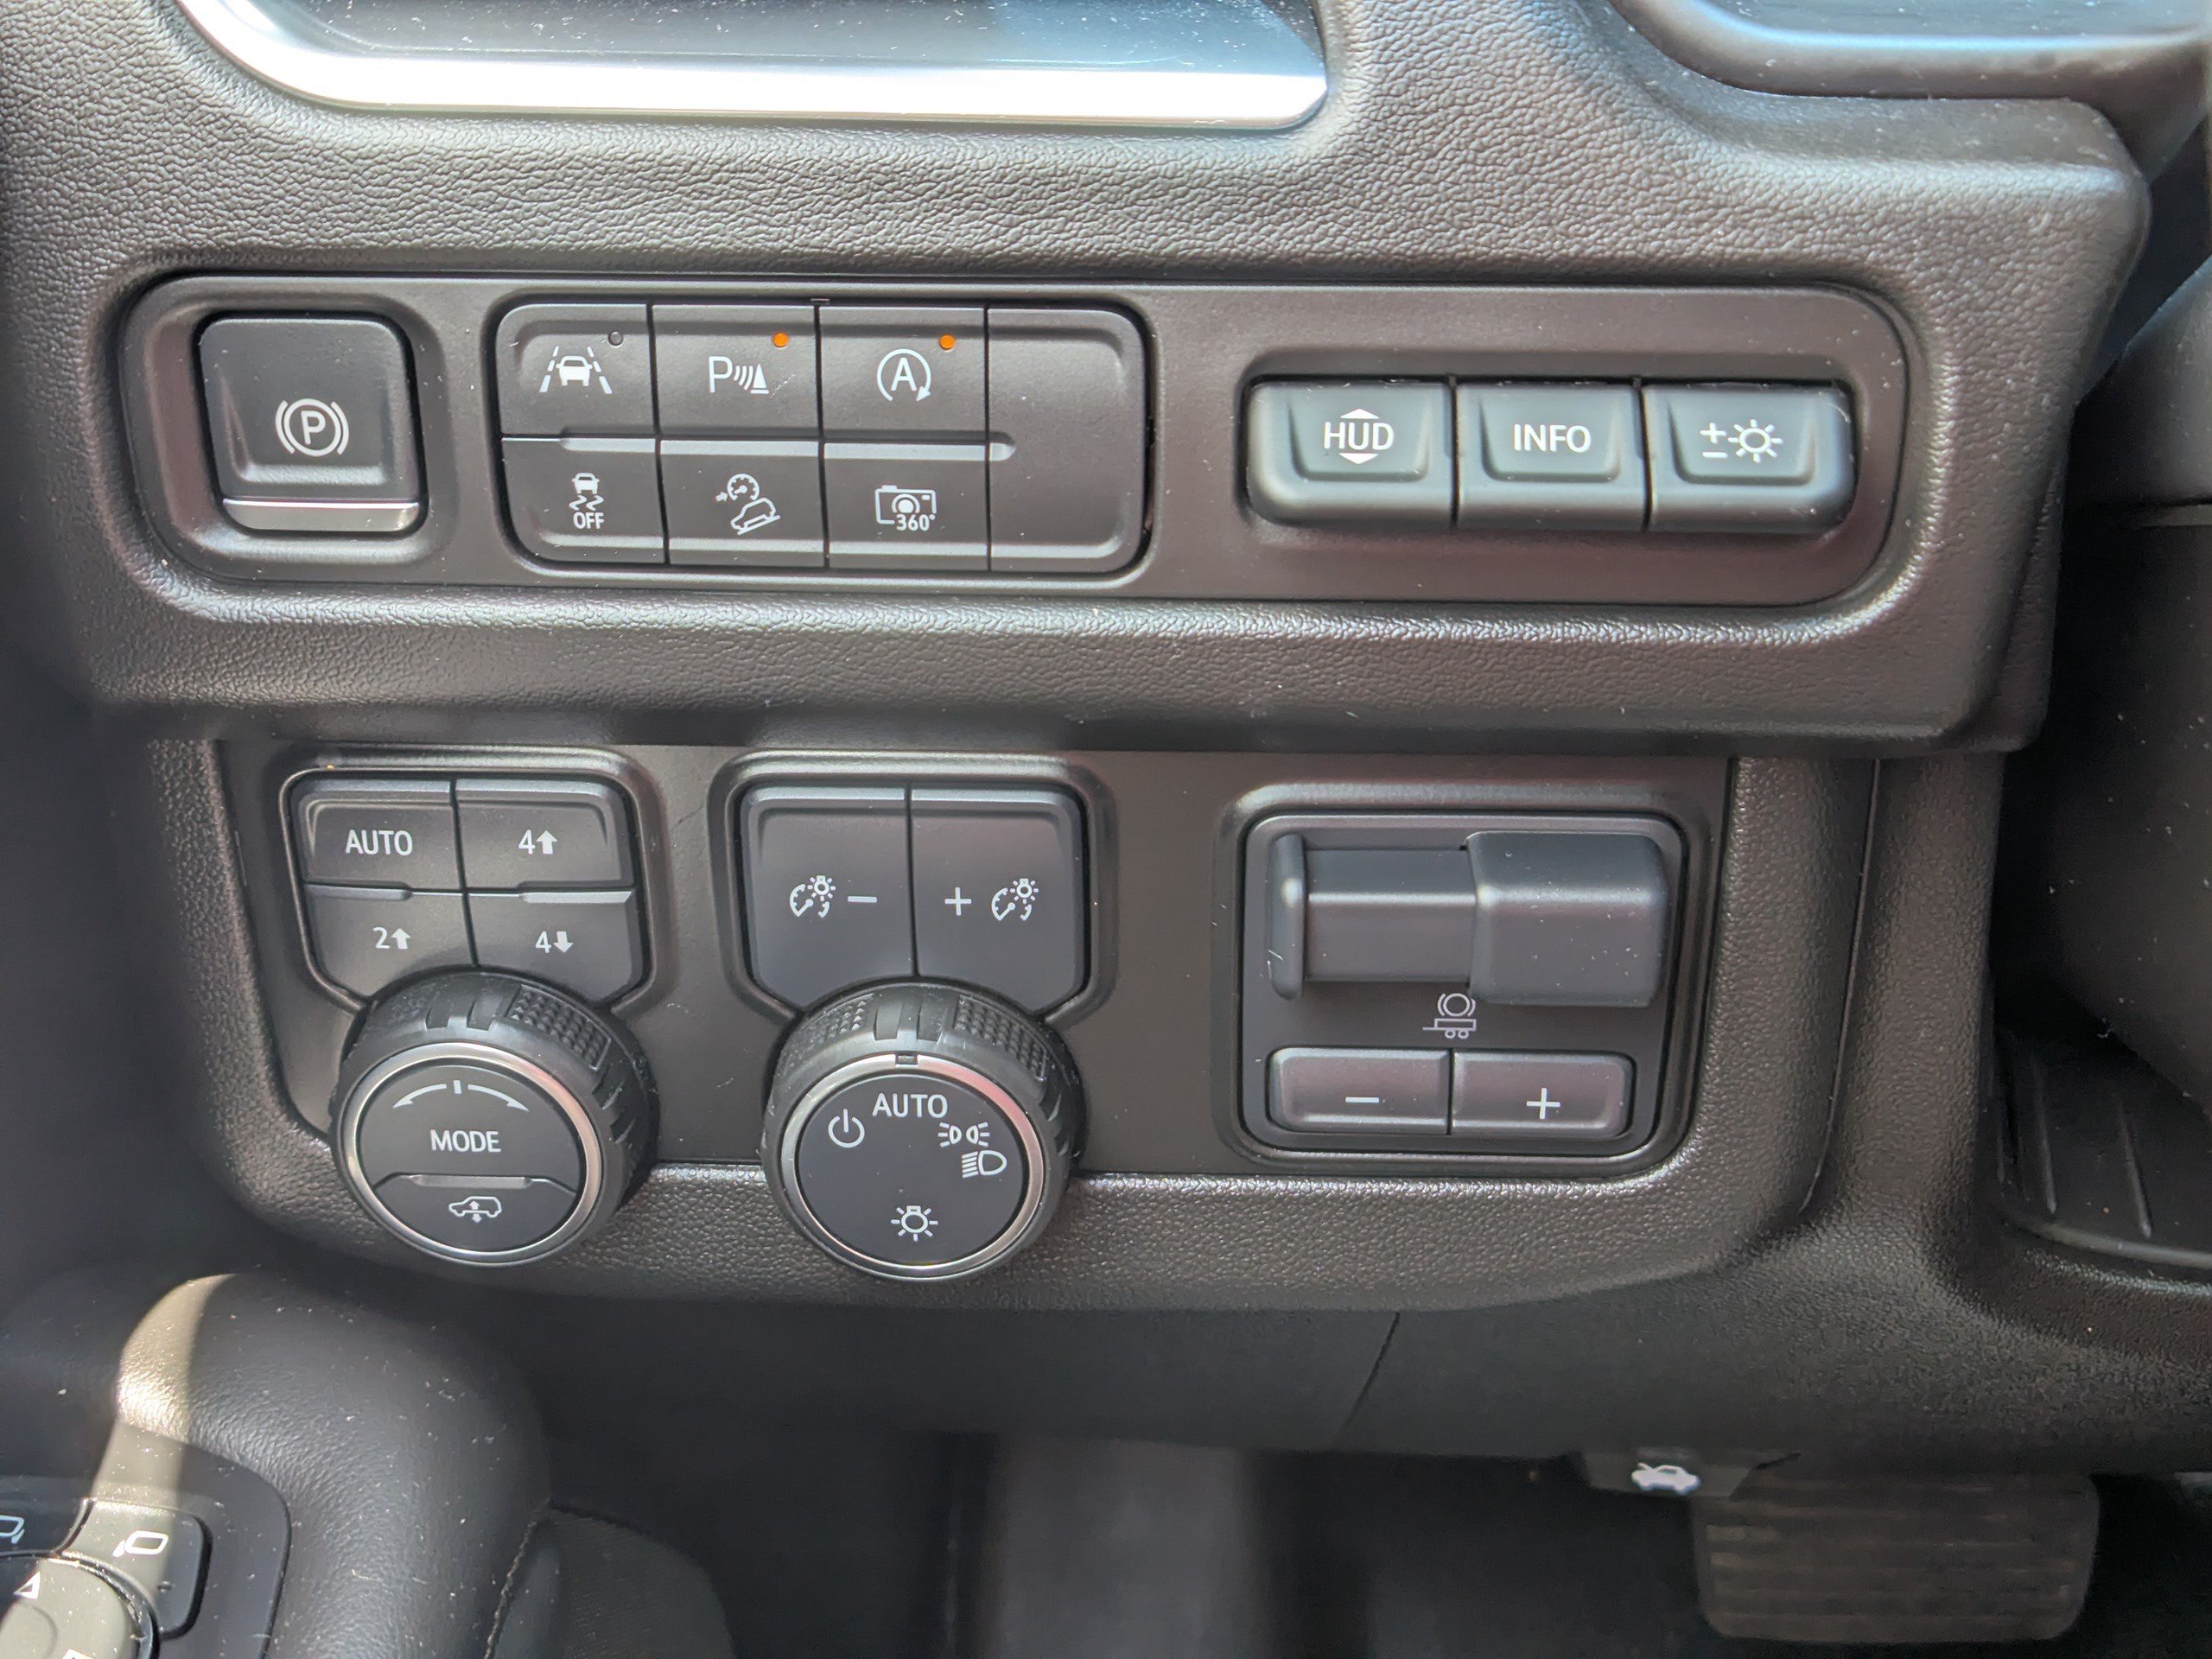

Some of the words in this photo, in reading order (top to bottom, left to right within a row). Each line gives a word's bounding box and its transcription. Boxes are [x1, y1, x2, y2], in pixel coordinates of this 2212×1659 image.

[709, 356, 733, 393] P
[890, 357, 917, 392] A
[1324, 423, 1395, 452] HUD
[1514, 423, 1591, 453] INFO
[574, 512, 605, 531] OFF
[345, 830, 413, 855] AUTO
[518, 830, 536, 855] 4
[373, 927, 390, 950] 2
[535, 931, 551, 954] 4
[872, 1093, 948, 1118] AUTO
[430, 1129, 501, 1153] MODE
